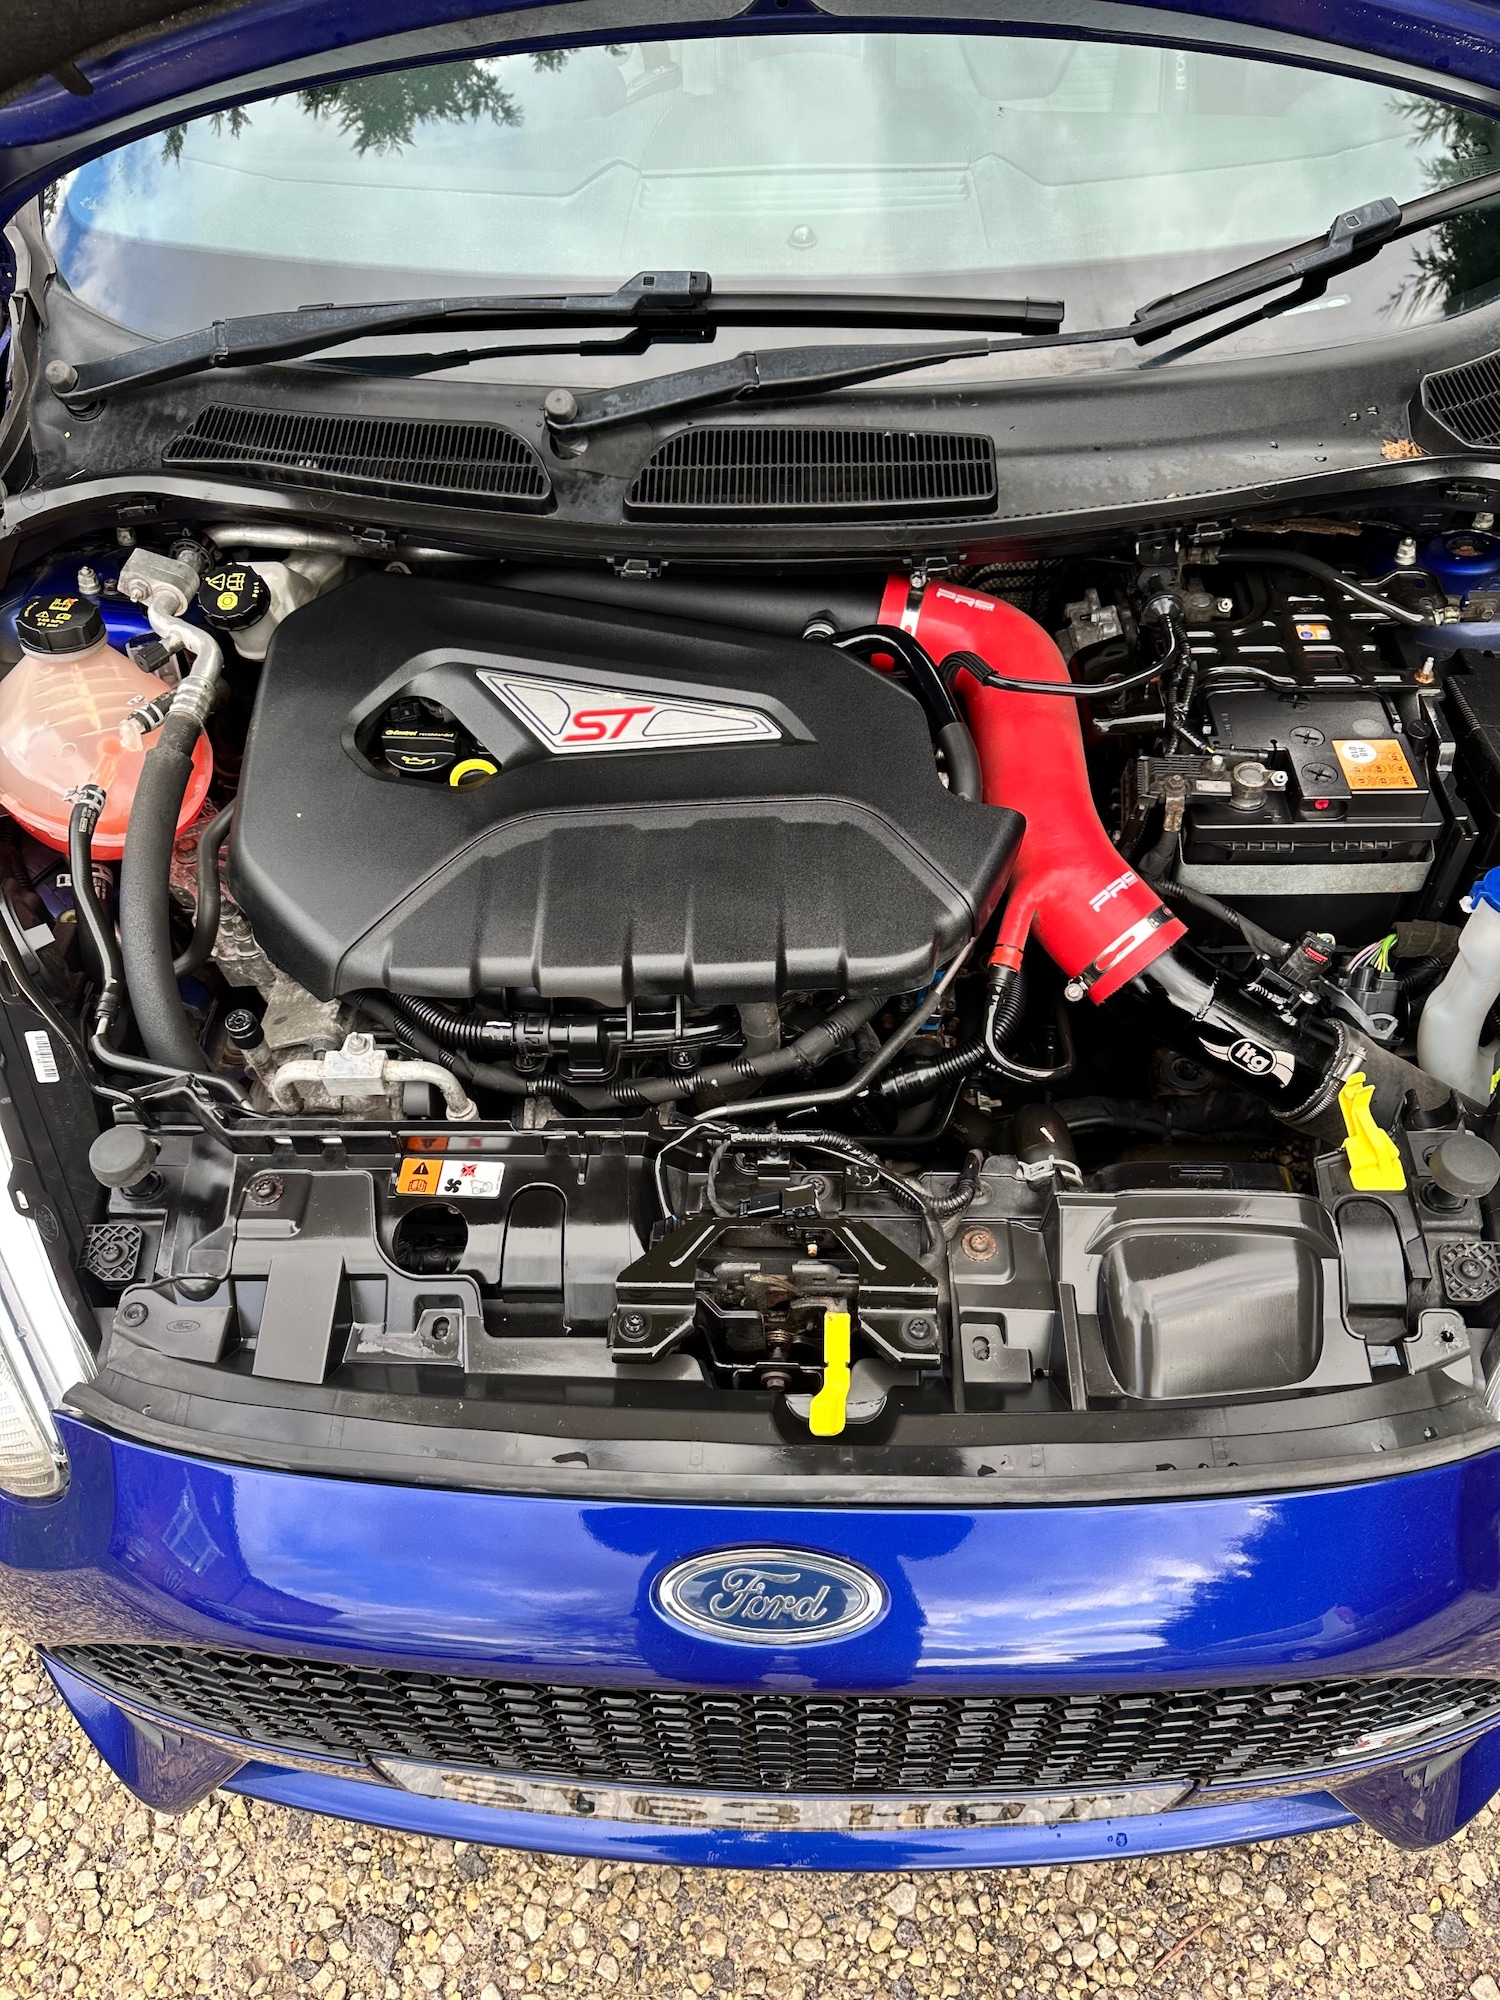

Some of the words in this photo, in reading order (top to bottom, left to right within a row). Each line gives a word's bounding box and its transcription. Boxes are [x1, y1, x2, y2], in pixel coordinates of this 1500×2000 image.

[936, 588, 995, 608] PRO
[561, 706, 656, 742] ST
[1348, 746, 1360, 758] 010
[1357, 747, 1368, 757] HB
[1088, 870, 1137, 912] PRO
[1235, 1042, 1270, 1072] itg
[709, 1568, 831, 1622] Ford
